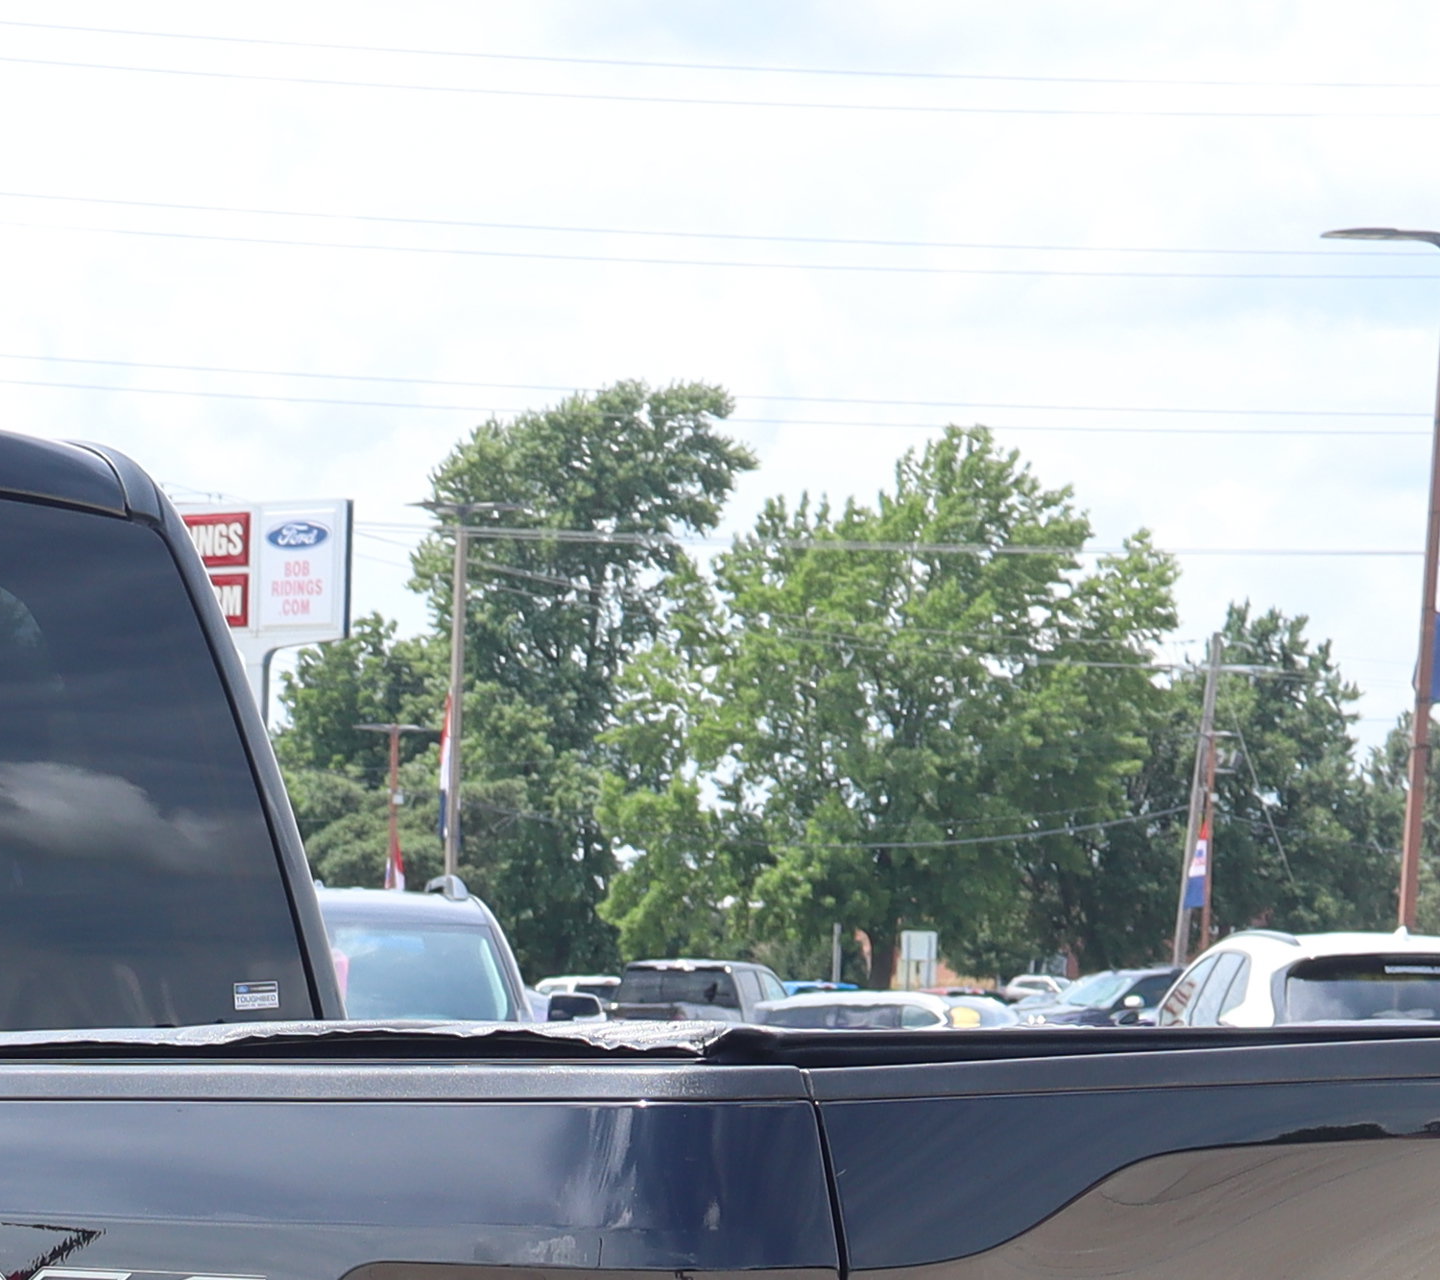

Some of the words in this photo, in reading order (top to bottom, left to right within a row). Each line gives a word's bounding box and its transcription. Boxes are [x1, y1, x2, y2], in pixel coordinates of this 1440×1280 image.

[277, 523, 317, 546] Ford
[284, 561, 310, 577] BOB
[271, 580, 323, 596] RIDINGS
[279, 599, 310, 616] .COM
